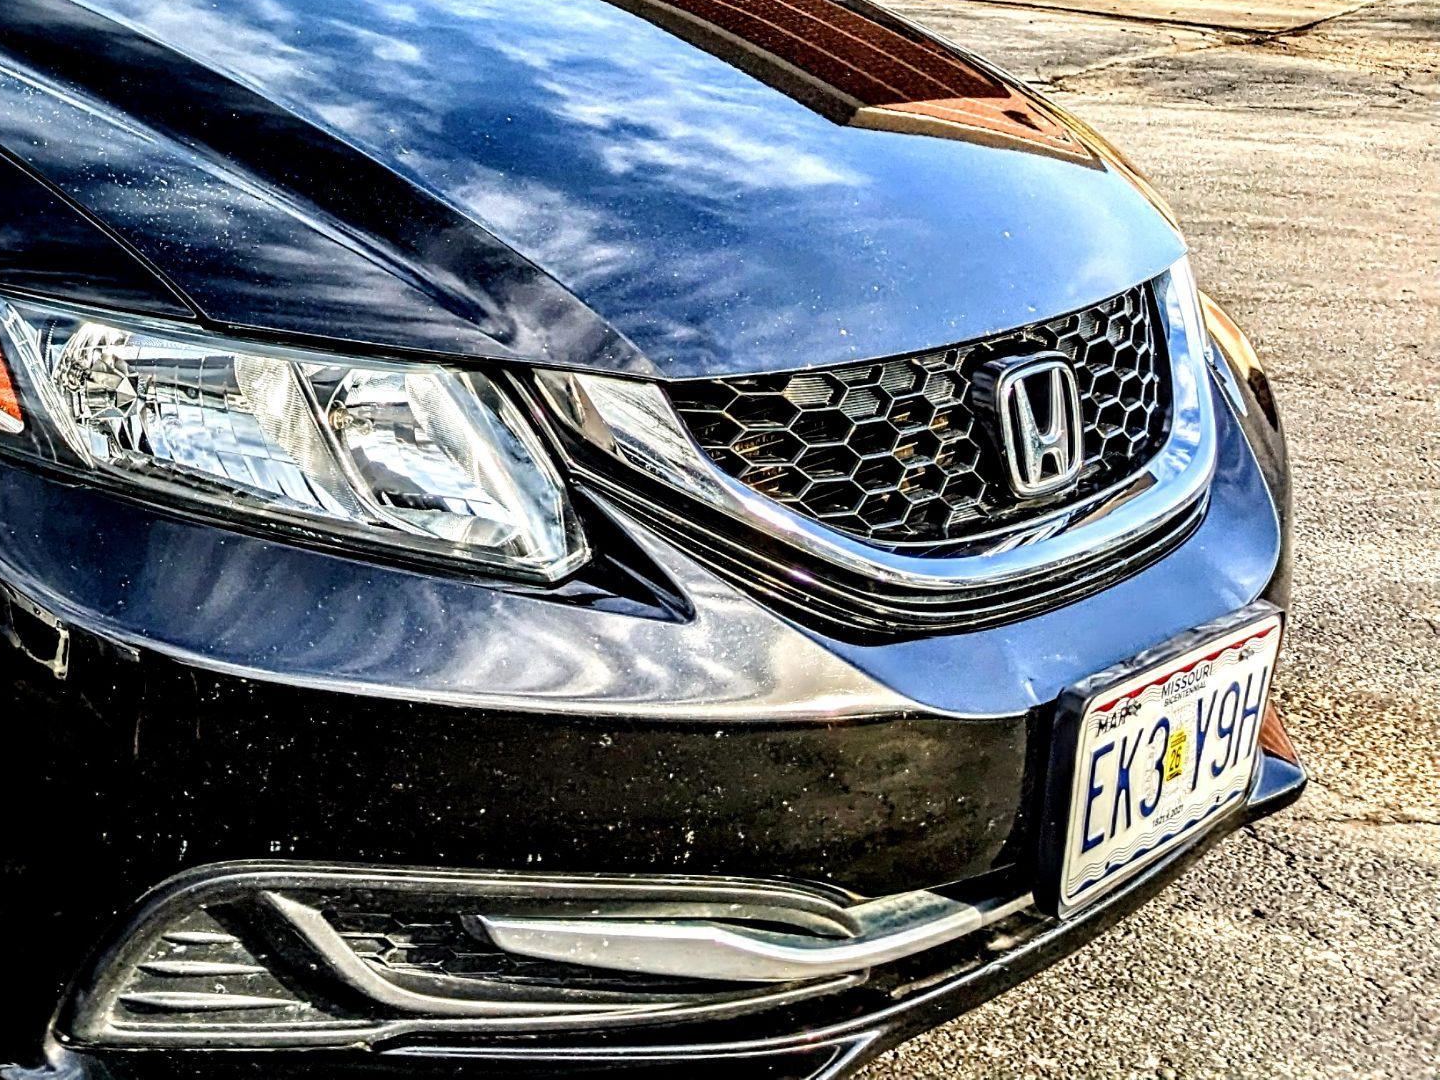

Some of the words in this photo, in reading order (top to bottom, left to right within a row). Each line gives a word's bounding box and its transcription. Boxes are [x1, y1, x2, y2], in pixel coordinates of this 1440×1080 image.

[1161, 662, 1213, 699] MISSOURI
[1164, 681, 1207, 707] BICENTENNIAL
[1081, 716, 1170, 855] EK3
[1191, 666, 1269, 793] Y9H
